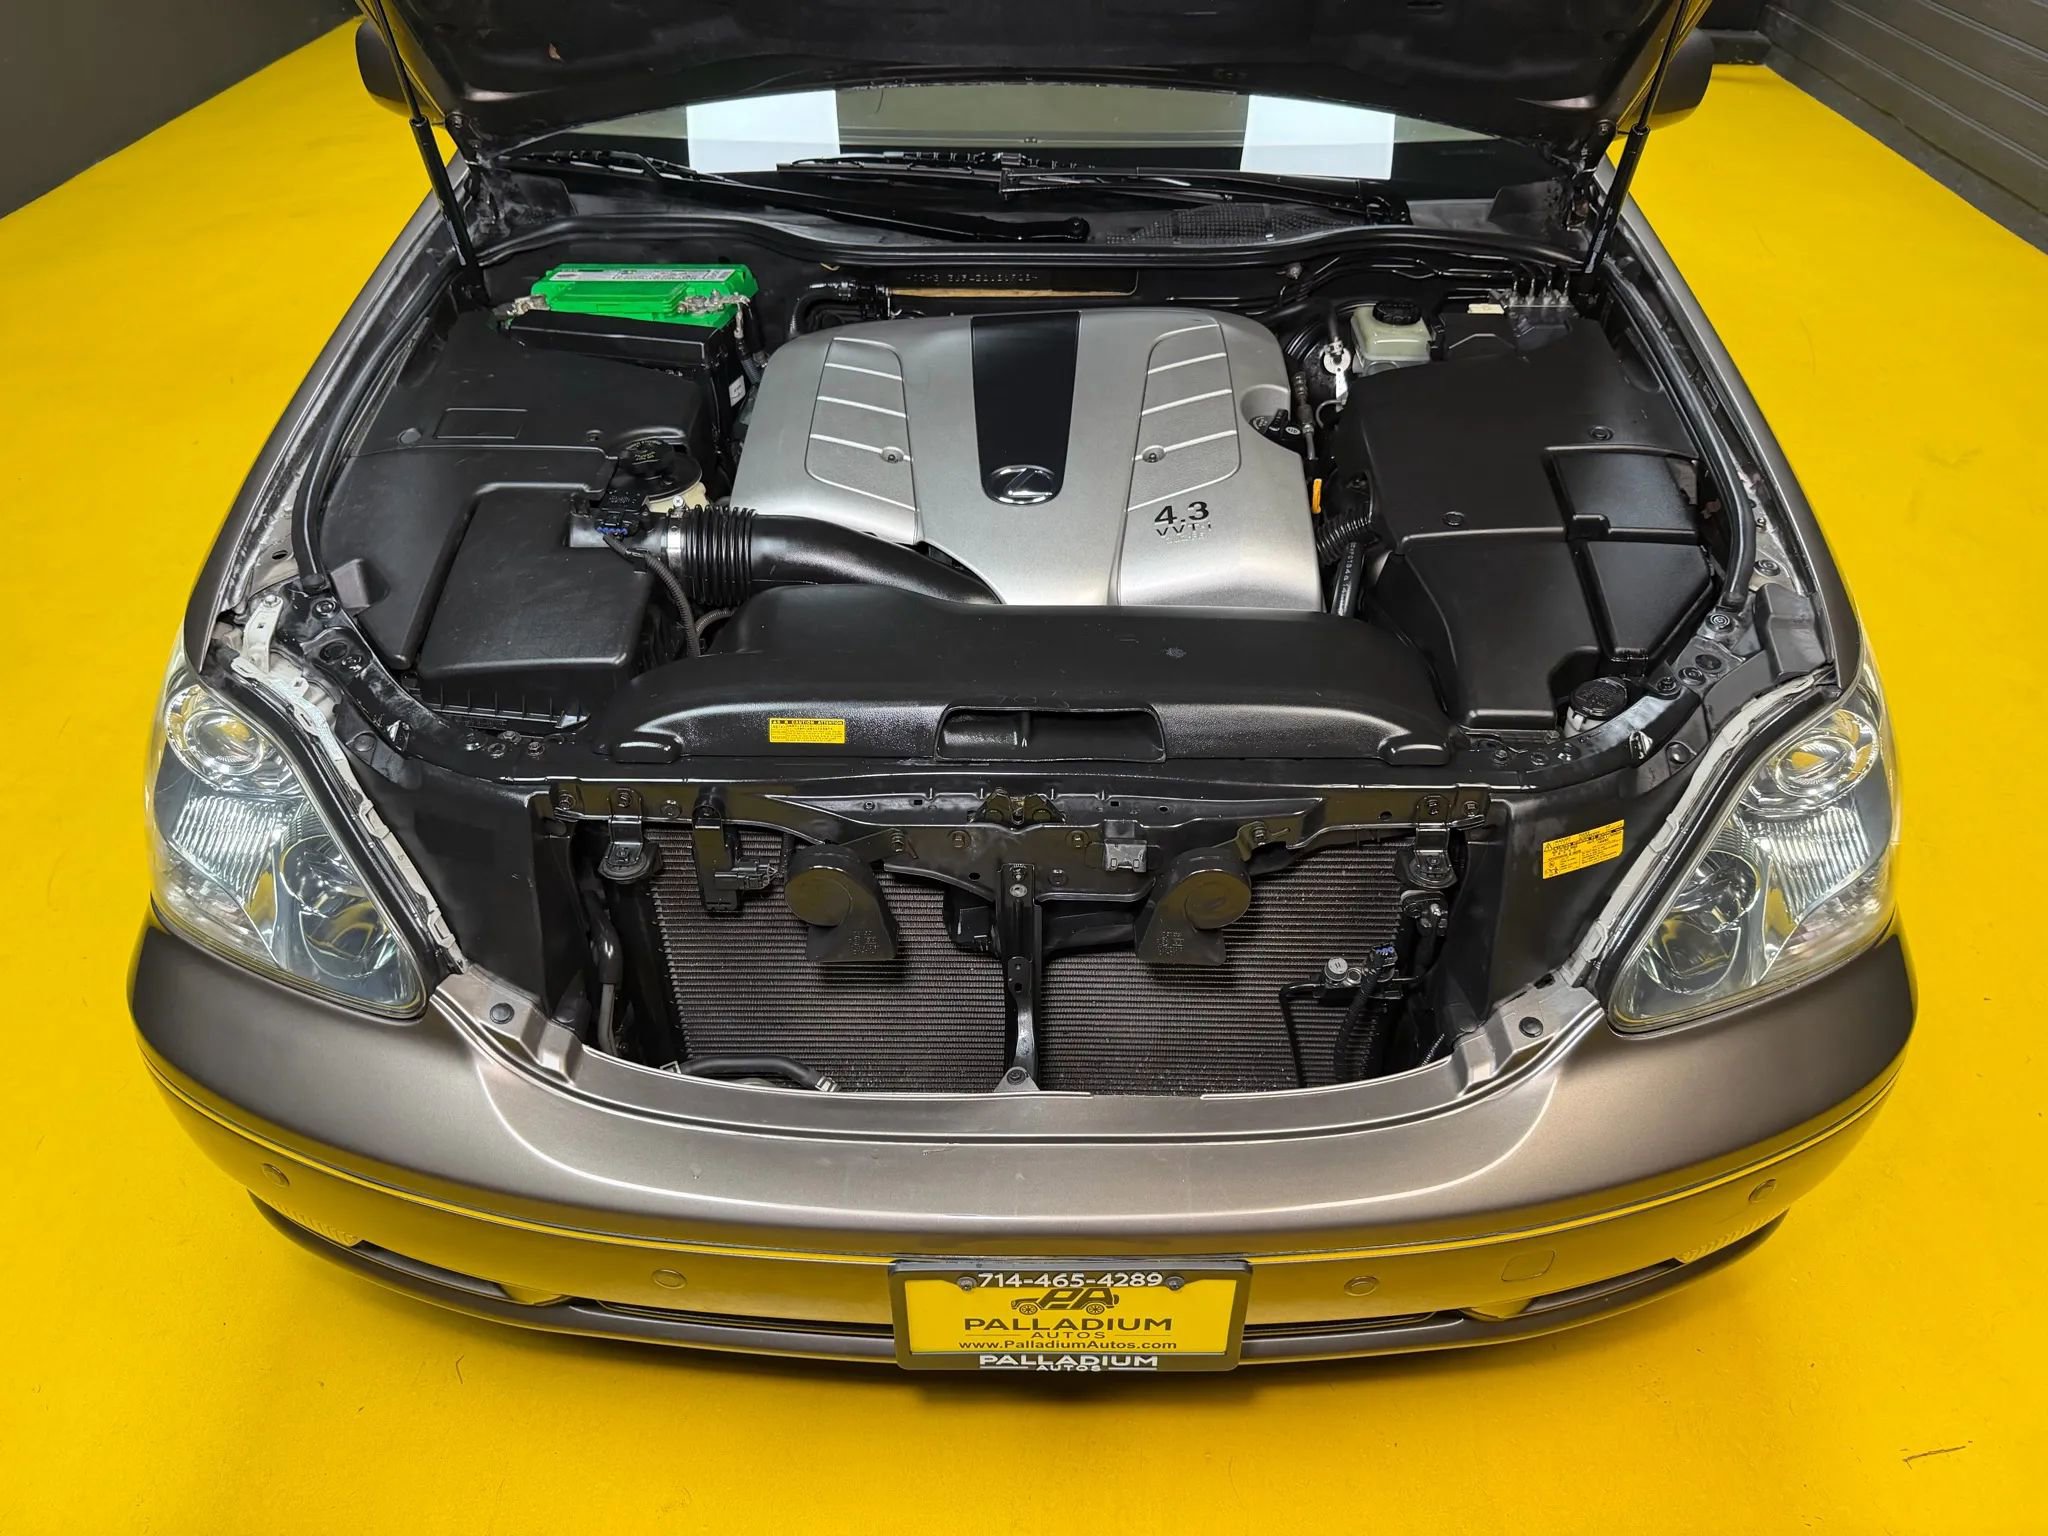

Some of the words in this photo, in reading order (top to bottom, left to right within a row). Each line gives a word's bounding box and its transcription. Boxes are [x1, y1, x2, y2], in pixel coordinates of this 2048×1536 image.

[1154, 501, 1209, 525] 4.3
[978, 1272, 1163, 1288] 714-465-4289
[964, 1318, 1172, 1331] PALLADIUM
[1031, 1331, 1106, 1339] AUTOS
[959, 1340, 1177, 1349] www.PalladiumAutos.com
[979, 1354, 1158, 1367] PALLADIUM
[1036, 1364, 1101, 1372] AUTOS
